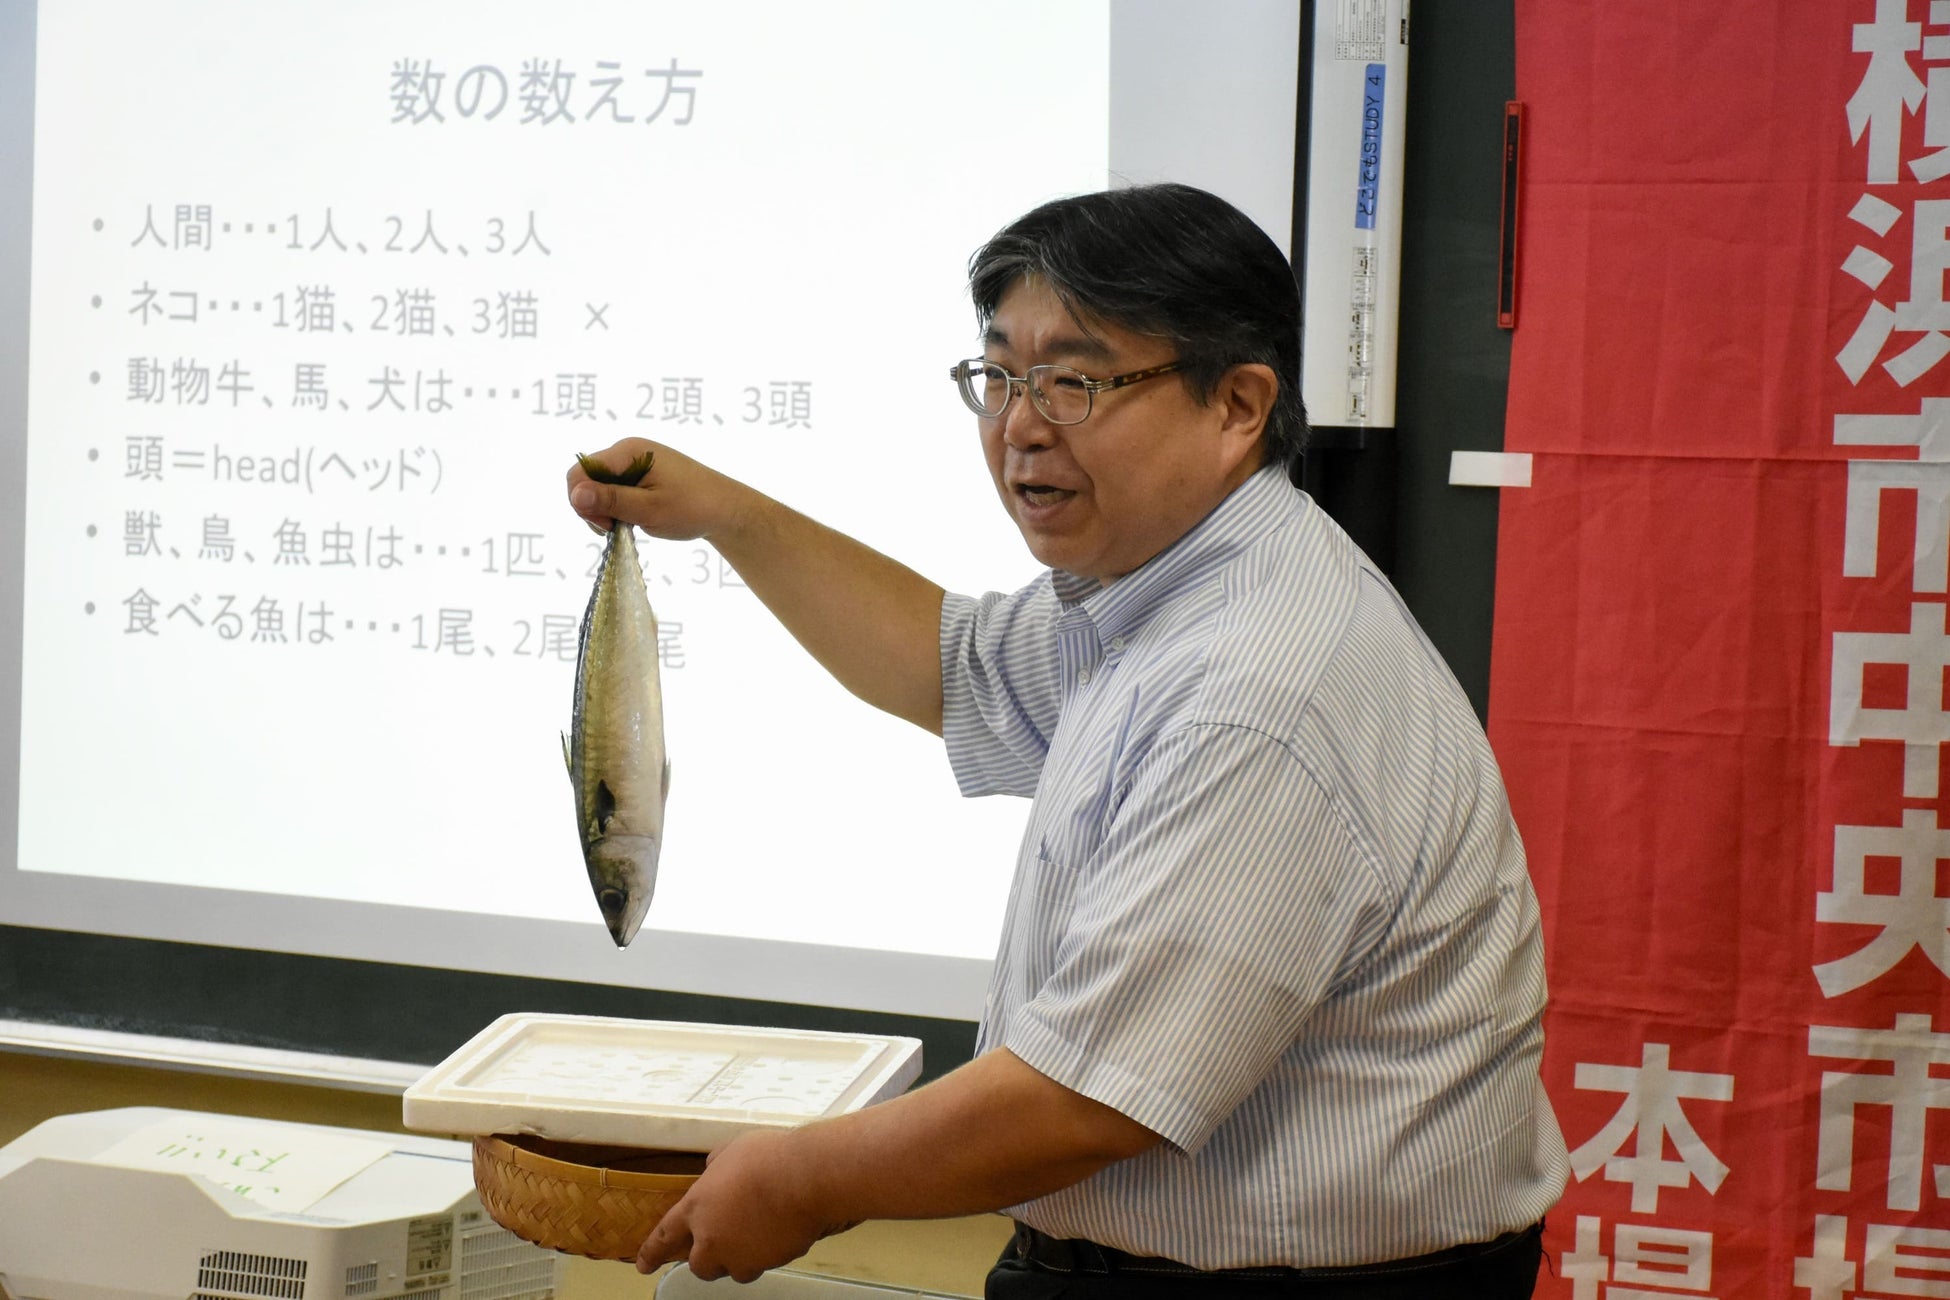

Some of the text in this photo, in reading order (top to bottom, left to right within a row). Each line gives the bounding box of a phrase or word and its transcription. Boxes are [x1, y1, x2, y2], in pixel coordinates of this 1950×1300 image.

[389, 56, 704, 127] 数の数え方
[1368, 74, 1382, 87] 4
